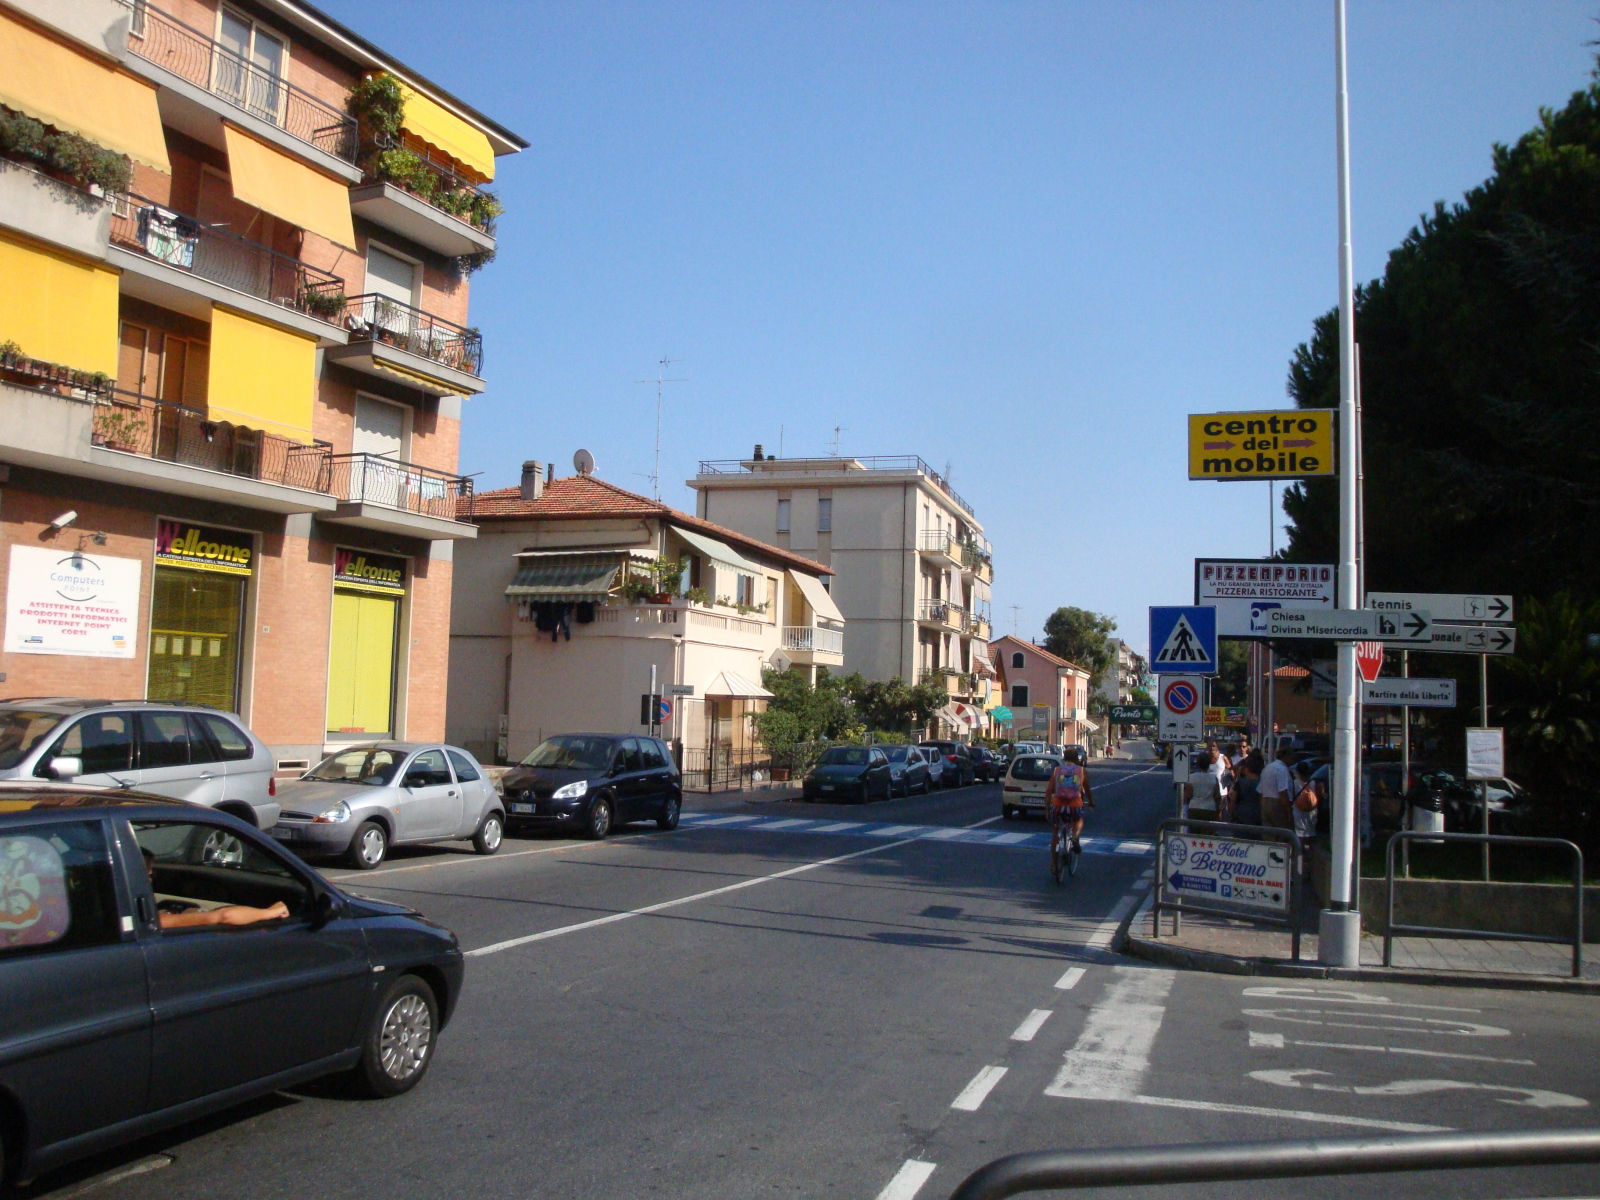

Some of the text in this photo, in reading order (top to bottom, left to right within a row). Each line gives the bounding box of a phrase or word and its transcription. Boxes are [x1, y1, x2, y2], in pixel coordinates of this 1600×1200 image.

[1203, 415, 1317, 436] centro
[1242, 436, 1278, 451] del
[1203, 452, 1320, 473] mobile
[156, 521, 251, 563] Wellcome
[335, 551, 401, 581] Wellcome
[50, 572, 105, 586] Computers
[1203, 565, 1331, 582] PIZZEMPORIO
[64, 585, 90, 593] POINT
[1216, 587, 1317, 597] PIZZERIA RISTORANTE
[29, 601, 120, 615] ASSISTENZA TECNICA
[1371, 599, 1412, 610] tennis
[19, 609, 127, 623] PRODOTTI INFORMATICI
[37, 619, 81, 627] INTERNET
[1271, 612, 1306, 621] Chiesa
[1271, 624, 1302, 634] Divina
[1306, 624, 1368, 635] Misericordia
[1369, 690, 1397, 699] Martire
[1399, 691, 1419, 699] della
[1112, 706, 1141, 717] Punto
[1215, 842, 1254, 858] Hotel
[1191, 850, 1267, 881] Bergamo
[1235, 876, 1255, 884] VICINO
[1266, 880, 1284, 888] MARE
